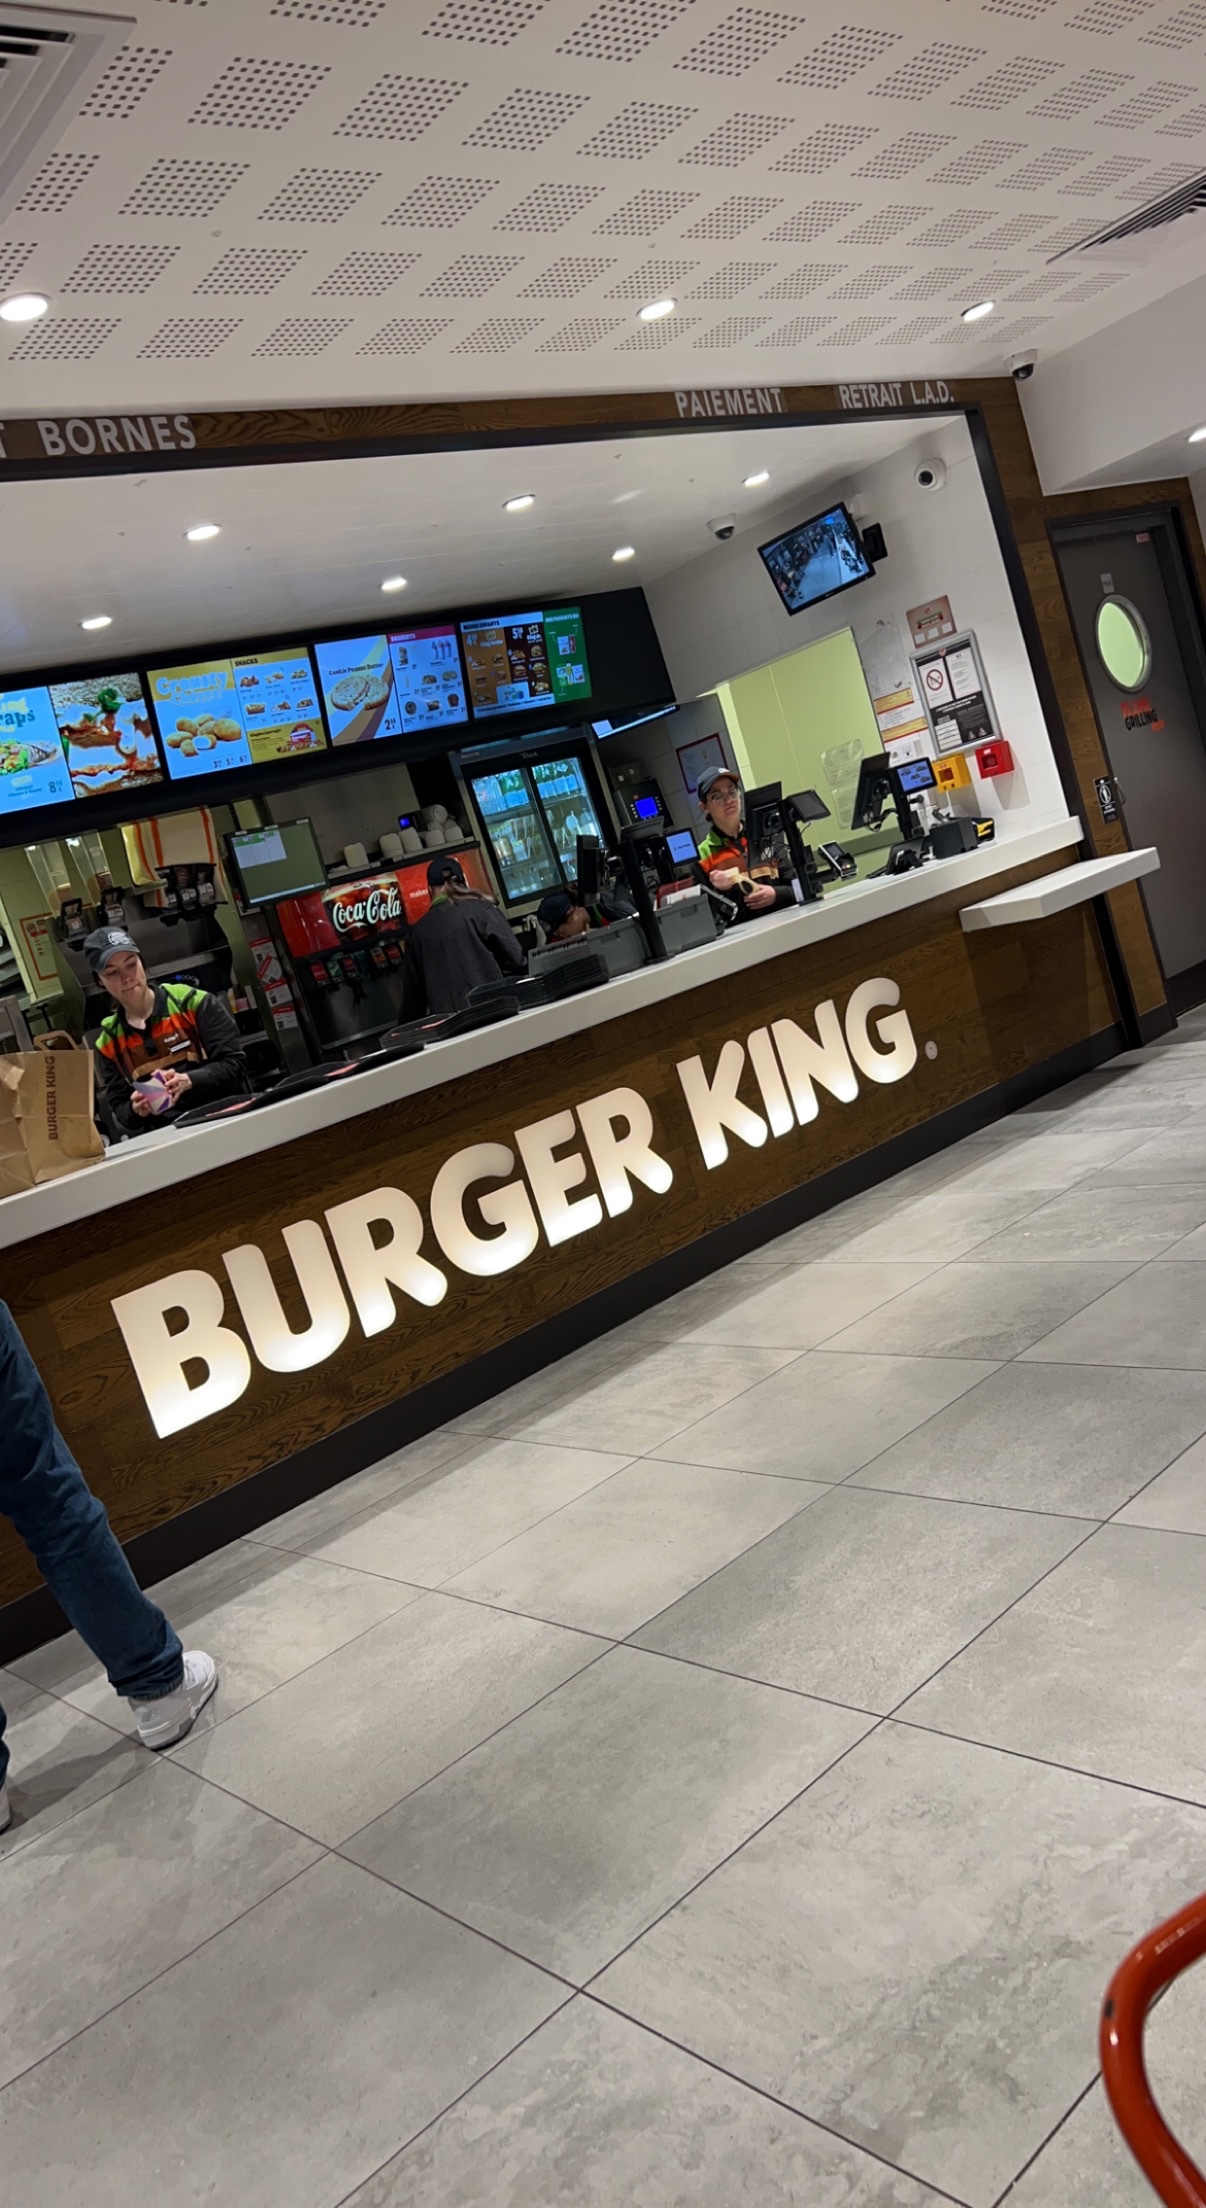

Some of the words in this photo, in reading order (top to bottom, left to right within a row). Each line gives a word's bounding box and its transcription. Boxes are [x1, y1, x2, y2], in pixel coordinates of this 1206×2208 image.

[674, 387, 782, 418] PAIEMENT
[839, 382, 902, 410] RETRAIT
[909, 380, 955, 406] L.A.D.
[37, 414, 197, 456] BORNES
[235, 658, 258, 667] SNACKS
[328, 668, 347, 676] Cookie
[156, 671, 228, 696] Crousty
[0, 710, 36, 728] aps
[1125, 708, 1157, 731] GRILLING
[333, 887, 402, 932] Coca-Cola
[45, 1055, 56, 1088] KING
[46, 1090, 58, 1141] BURGER
[111, 1087, 673, 1438] BURGER
[677, 977, 918, 1170] KING
